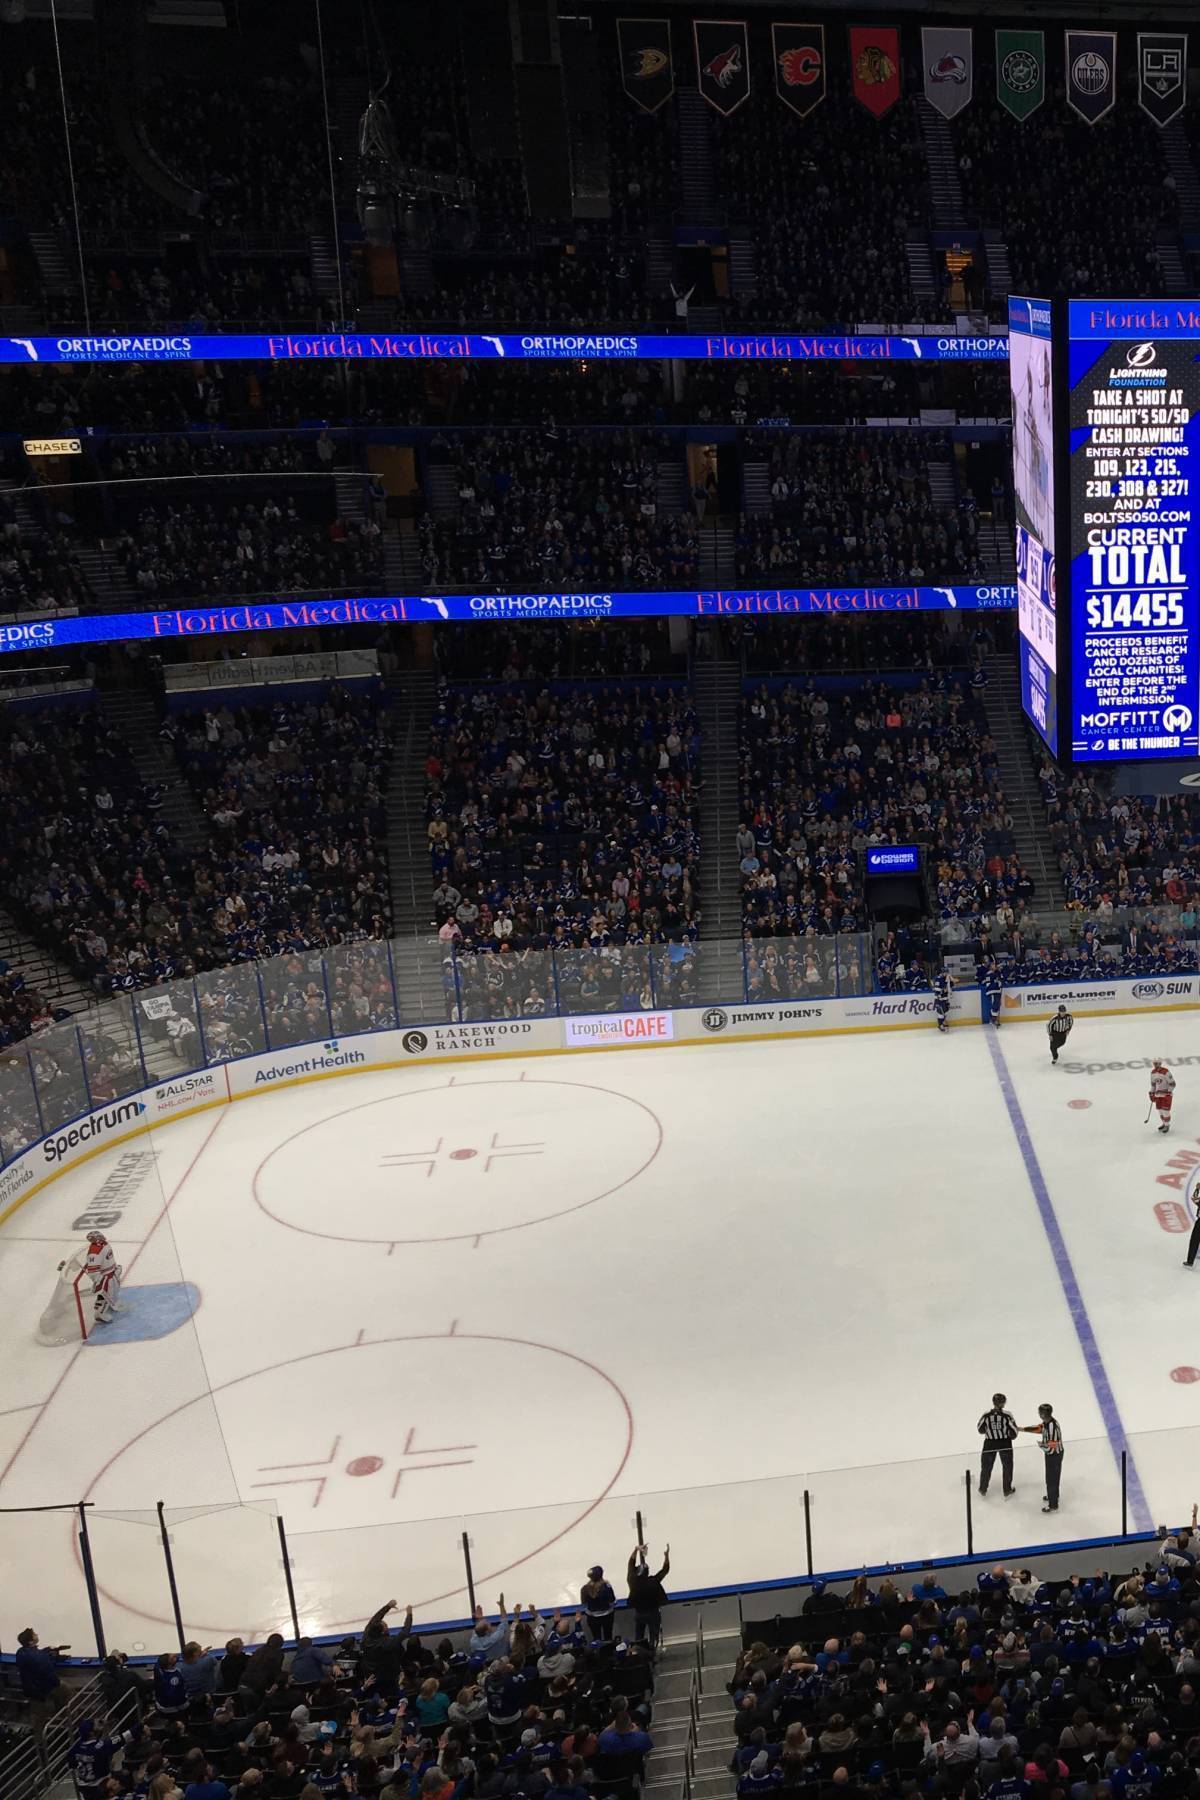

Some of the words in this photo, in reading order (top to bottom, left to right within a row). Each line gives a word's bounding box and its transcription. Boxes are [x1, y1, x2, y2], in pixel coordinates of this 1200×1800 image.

[1147, 53, 1178, 70] LA
[1090, 309, 1169, 329] Florida
[57, 337, 191, 353] ORTHOPAEDICS
[269, 336, 362, 357] Florida
[370, 336, 471, 356] Medical
[521, 337, 638, 351] ORTHOPAEDICS
[706, 337, 792, 357] Florida
[799, 336, 891, 356] Medical
[60, 351, 98, 359] SPORTS
[1109, 368, 1167, 379] LIGHTNING
[1108, 378, 1166, 387] FOUNDATION
[1092, 390, 1122, 406] TAKE
[1125, 390, 1134, 405] A
[1136, 389, 1166, 405] SHOT
[1168, 389, 1184, 405] AT
[1086, 409, 1148, 425] TONIGHT'S
[1151, 408, 1190, 425] 50/50
[1091, 428, 1123, 444] CASH
[1124, 427, 1185, 444] DRAWING!
[24, 442, 70, 453] CHASE
[1086, 447, 1121, 457] ENTER
[1122, 447, 1136, 457] AT
[1137, 446, 1189, 457] SECTIONS
[1093, 460, 1123, 478] 109,
[1125, 460, 1152, 478] 123,
[1154, 459, 1181, 477] 215,
[1086, 481, 1116, 498] 230,
[1118, 480, 1145, 497] 308
[1146, 480, 1158, 497] &
[1160, 480, 1189, 497] 327!
[1113, 499, 1143, 510] AND
[1145, 498, 1162, 510] AT
[1083, 511, 1191, 524] BOLTS5050.COM
[1087, 527, 1187, 546] CURRENT
[1087, 544, 1187, 586] TOTAL
[469, 595, 613, 611] ORTHOPAEDICS
[696, 591, 794, 614] Florida
[809, 588, 919, 611] Medical
[152, 605, 272, 636] Florida
[282, 599, 408, 627] Medical
[1086, 592, 1184, 628] $14455
[0, 622, 55, 643] EDICS
[1085, 637, 1142, 648] PROCEEDS
[1144, 635, 1189, 646] BENEFIT
[1085, 647, 1129, 657] CANCER
[1131, 646, 1188, 656] RESEARCH
[1093, 657, 1118, 667] AND
[1119, 656, 1163, 666] DOZENS
[1164, 655, 1180, 665] OF
[1088, 667, 1124, 677] LOCAL
[1125, 665, 1185, 676] CHARITIES!
[1085, 677, 1121, 688] ENTER
[1122, 676, 1165, 687] BEFORE
[1166, 675, 1187, 686] THE
[1096, 687, 1120, 697] END
[1121, 686, 1136, 696] OF
[1136, 686, 1160, 696] THE
[1160, 685, 1177, 695] 2ND
[1098, 694, 1175, 706] INTERMISSION
[1080, 711, 1160, 728] MOFFITT
[1081, 726, 1121, 736] CANCER
[1123, 725, 1161, 735] CENTER
[1107, 738, 1120, 751] BE
[1121, 737, 1138, 750] THE
[1139, 735, 1180, 749] THUNDER
[1026, 989, 1116, 1002] MicroLumen
[1138, 983, 1158, 994] FOX
[1166, 982, 1193, 995] SUN
[872, 1000, 908, 1016] Hard
[731, 1010, 775, 1025] JIMMY
[778, 1008, 823, 1022] JOHN'S
[434, 1023, 532, 1040] LAKEWOOD
[572, 1018, 624, 1037] tropical
[624, 1015, 668, 1038] CAFE
[436, 1036, 496, 1051] RANCH
[254, 1049, 365, 1084] AdventHealth
[43, 1100, 140, 1162] Spectrum
